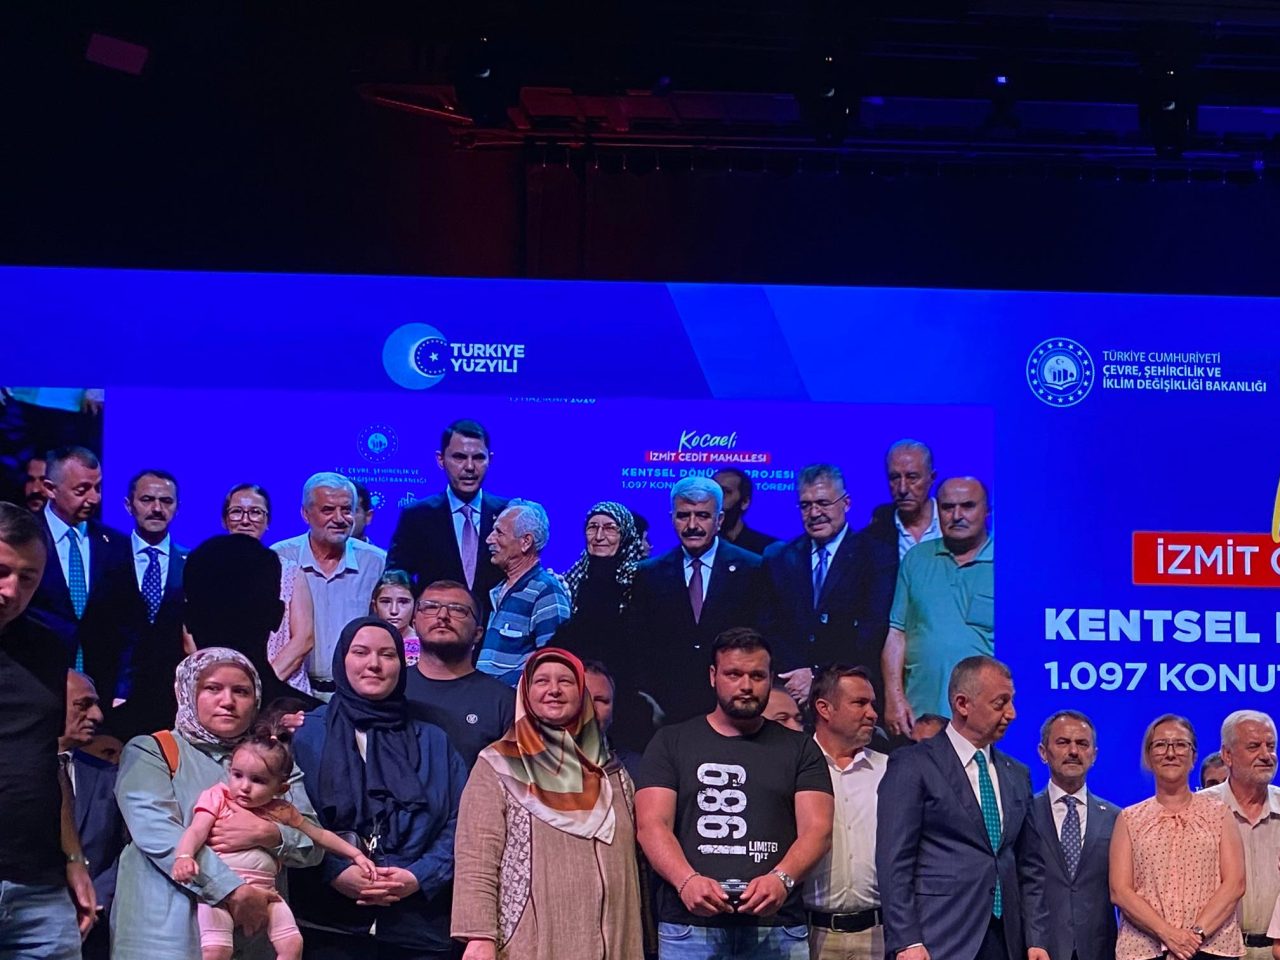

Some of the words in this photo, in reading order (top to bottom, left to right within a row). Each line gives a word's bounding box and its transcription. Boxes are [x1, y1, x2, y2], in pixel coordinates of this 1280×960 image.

[1103, 350, 1146, 363] TÜRKİYE
[1149, 351, 1221, 364] CUMHURİYETİ
[1103, 365, 1142, 378] ÇEVRE,
[1144, 365, 1204, 379] ŞEHİRCİLİK
[1206, 367, 1221, 378] VE
[1103, 377, 1134, 389] İKLİM
[1137, 378, 1203, 393] DEĞİŞİKLİĞİ
[1206, 379, 1267, 392] BAKANLIĞI
[679, 431, 737, 452] Kocaeli
[650, 451, 676, 461] İZMİT
[679, 452, 708, 462] CEDİT
[622, 468, 675, 477] KENTSEL
[622, 481, 647, 489] 1.097
[1158, 538, 1259, 575] İZMİT
[1045, 608, 1260, 643] KENTSEL
[1045, 662, 1147, 690] 1.097
[697, 762, 747, 855] 1989
